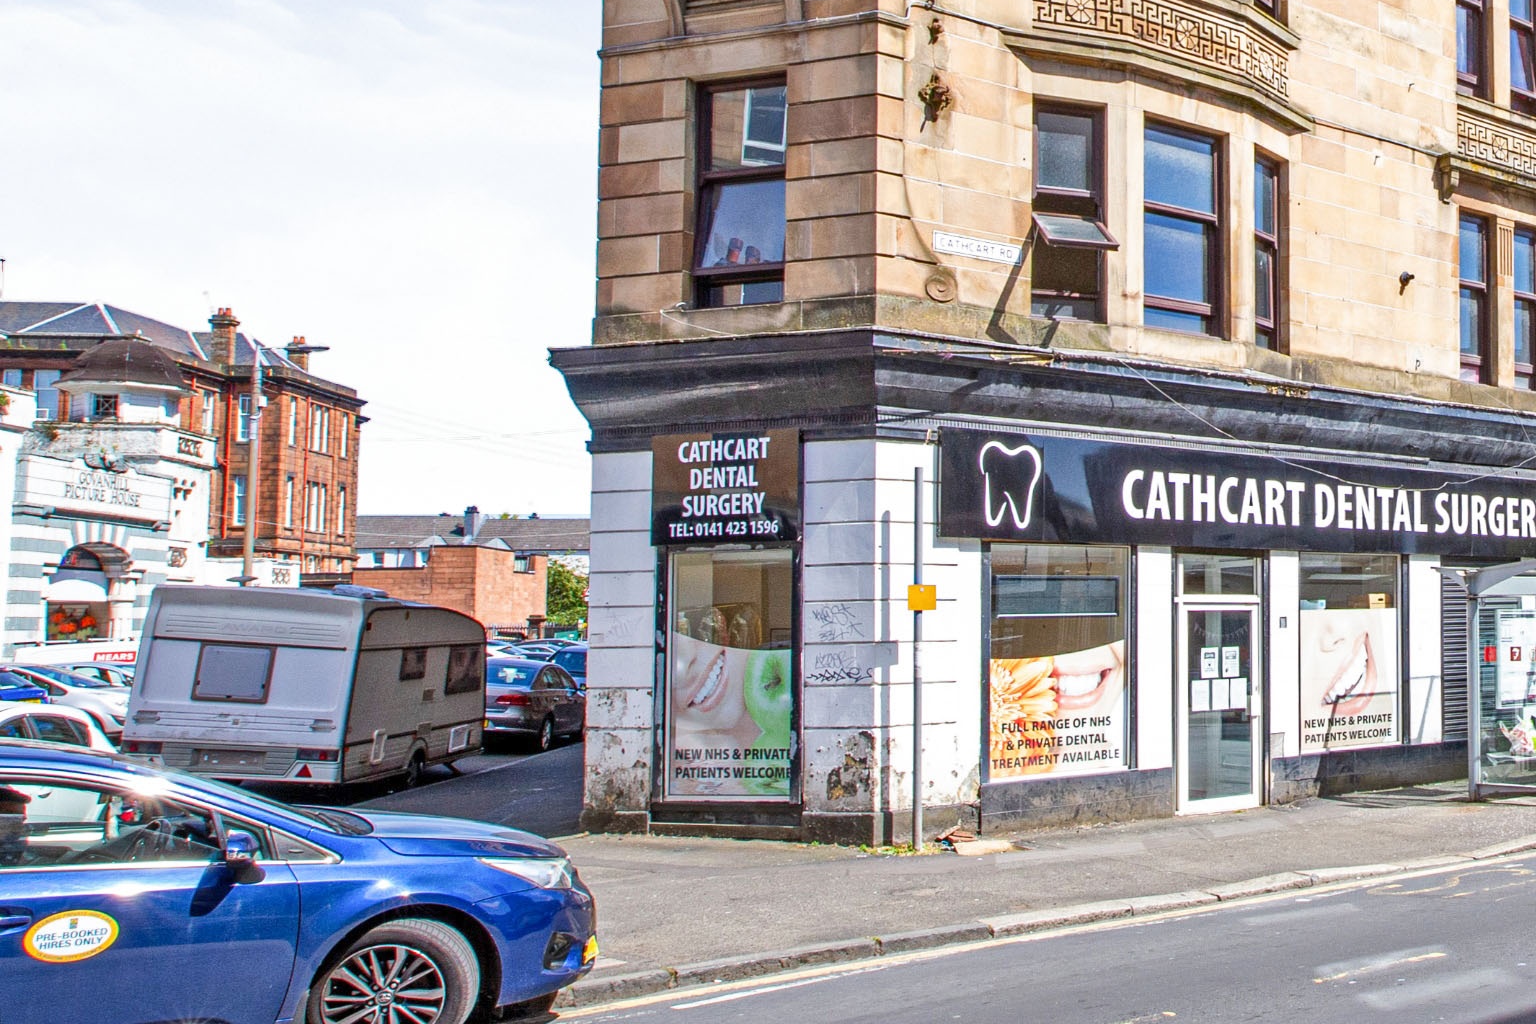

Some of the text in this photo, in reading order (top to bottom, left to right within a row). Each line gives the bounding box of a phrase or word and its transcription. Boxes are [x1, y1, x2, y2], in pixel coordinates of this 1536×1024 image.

[939, 237, 1013, 259] CATHCART RD
[677, 436, 771, 463] CATHCART
[79, 471, 129, 492] GOVANHILL
[690, 465, 758, 490] DENTAL
[64, 483, 141, 507] PICTURE HOUSE
[1121, 469, 1305, 527] CATHCART
[1314, 483, 1429, 533] DENTAL
[681, 492, 766, 518] SURGERY
[669, 520, 779, 538] TEL: 0141 423 1596
[95, 652, 135, 662] MEARS
[1001, 715, 1112, 734] FULL RANGE OF NHS
[1304, 713, 1393, 729] NEW NHS & PRIVATE
[1006, 733, 1108, 751] & PRIVATE DENTAL
[1304, 727, 1392, 744] PATIENTS WELCOME
[675, 748, 703, 760] NEW
[705, 748, 730, 760] NHS
[732, 748, 741, 760] &
[991, 748, 1120, 770] TREATMENT AVAILABLE
[675, 766, 731, 779] PATIENTS
[35, 927, 109, 943] PRE-BOOKED
[39, 936, 104, 950] HIRES ONLY
